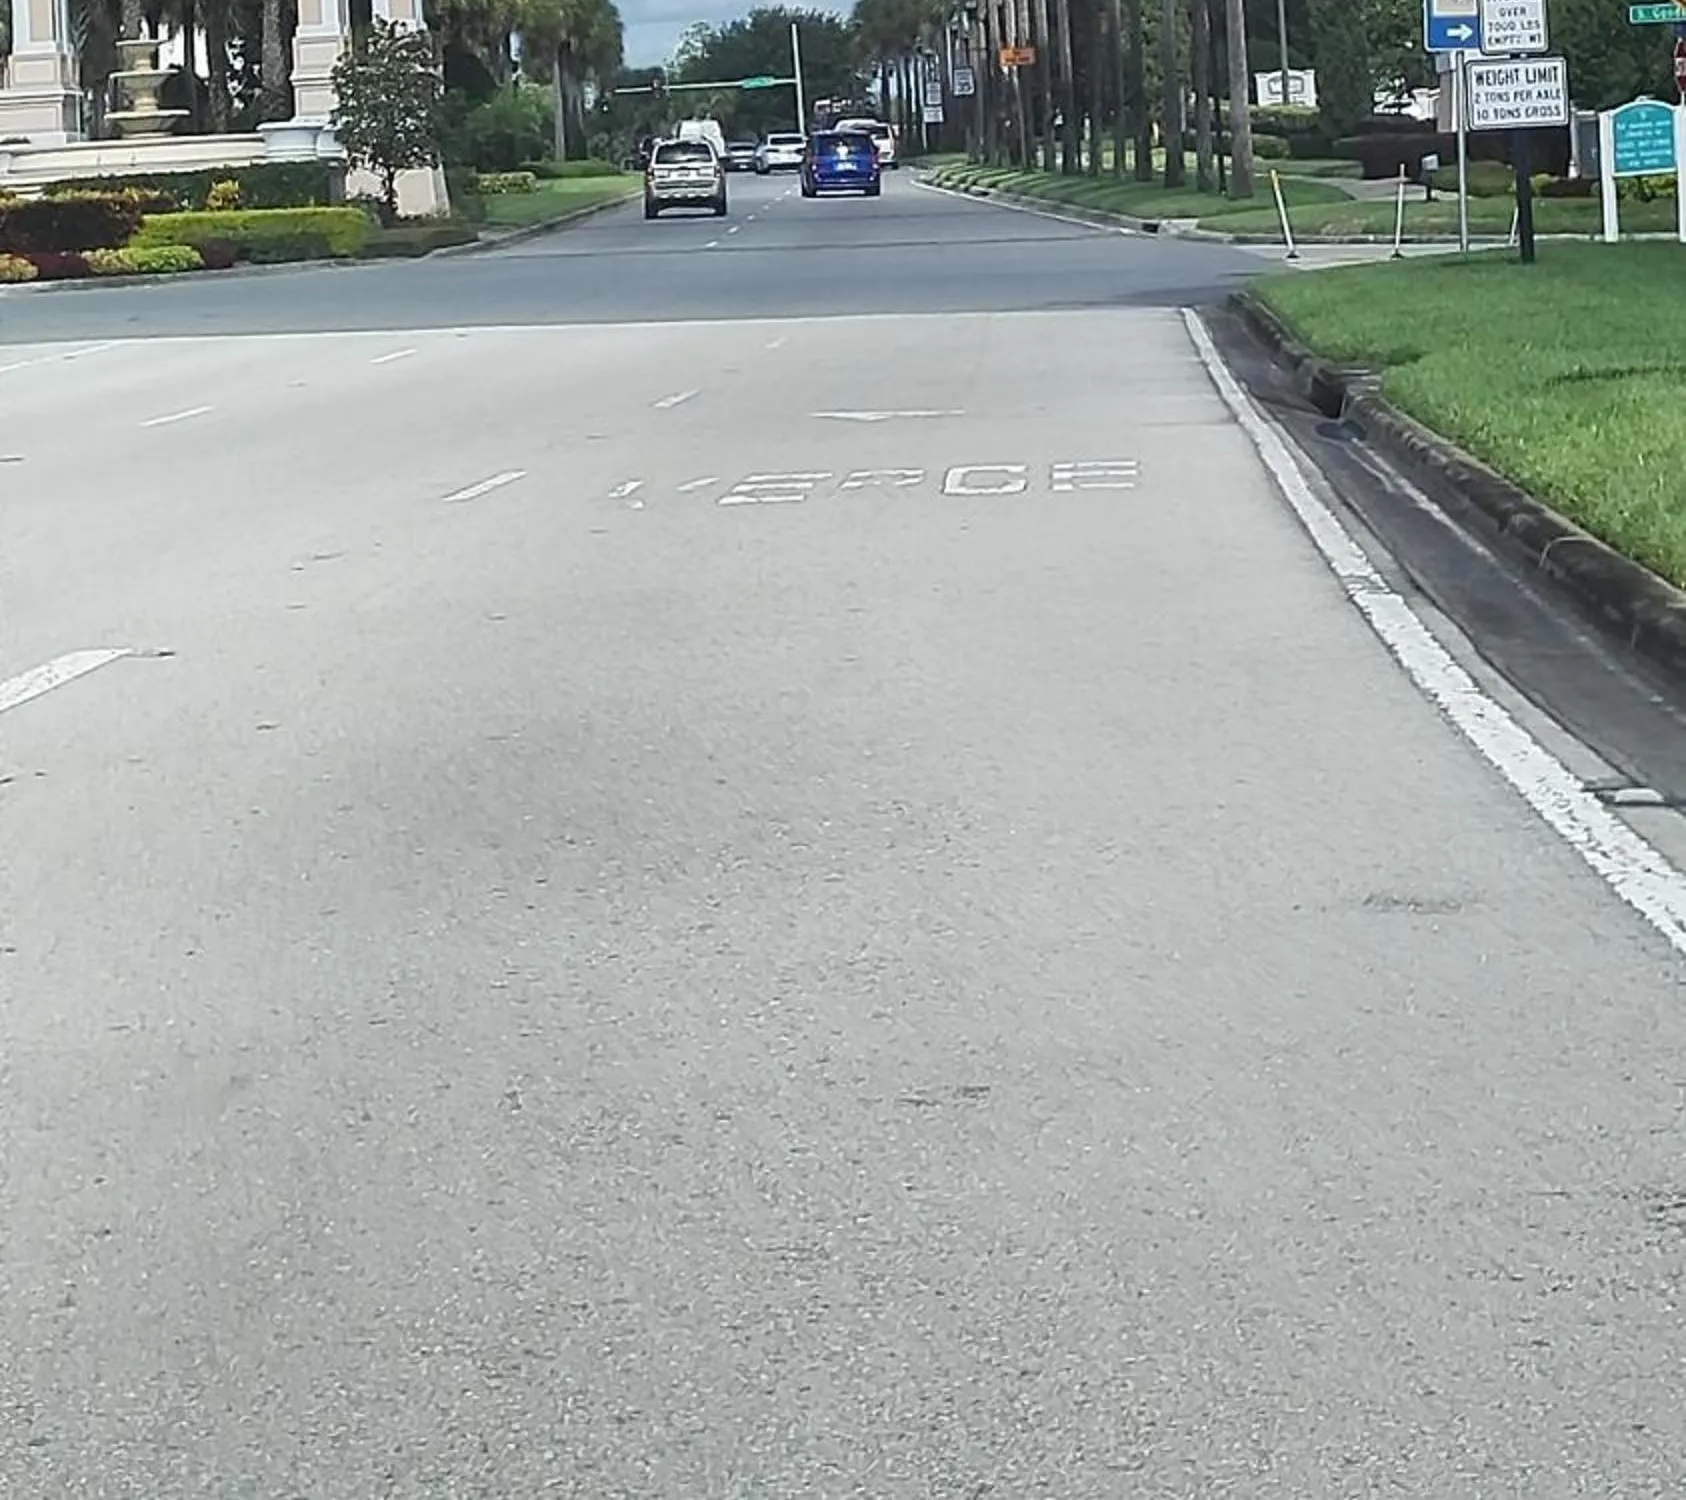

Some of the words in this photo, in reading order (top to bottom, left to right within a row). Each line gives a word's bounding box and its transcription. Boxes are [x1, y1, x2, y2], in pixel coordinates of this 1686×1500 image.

[1499, 6, 1526, 17] OVER
[1474, 68, 1519, 87] WEIGHT
[1525, 66, 1558, 84] LIMIT
[1484, 91, 1510, 102] TONS
[1513, 90, 1533, 102] PER
[1536, 88, 1561, 100] AXLE
[1477, 108, 1489, 120] 10
[1493, 107, 1521, 119] TONS
